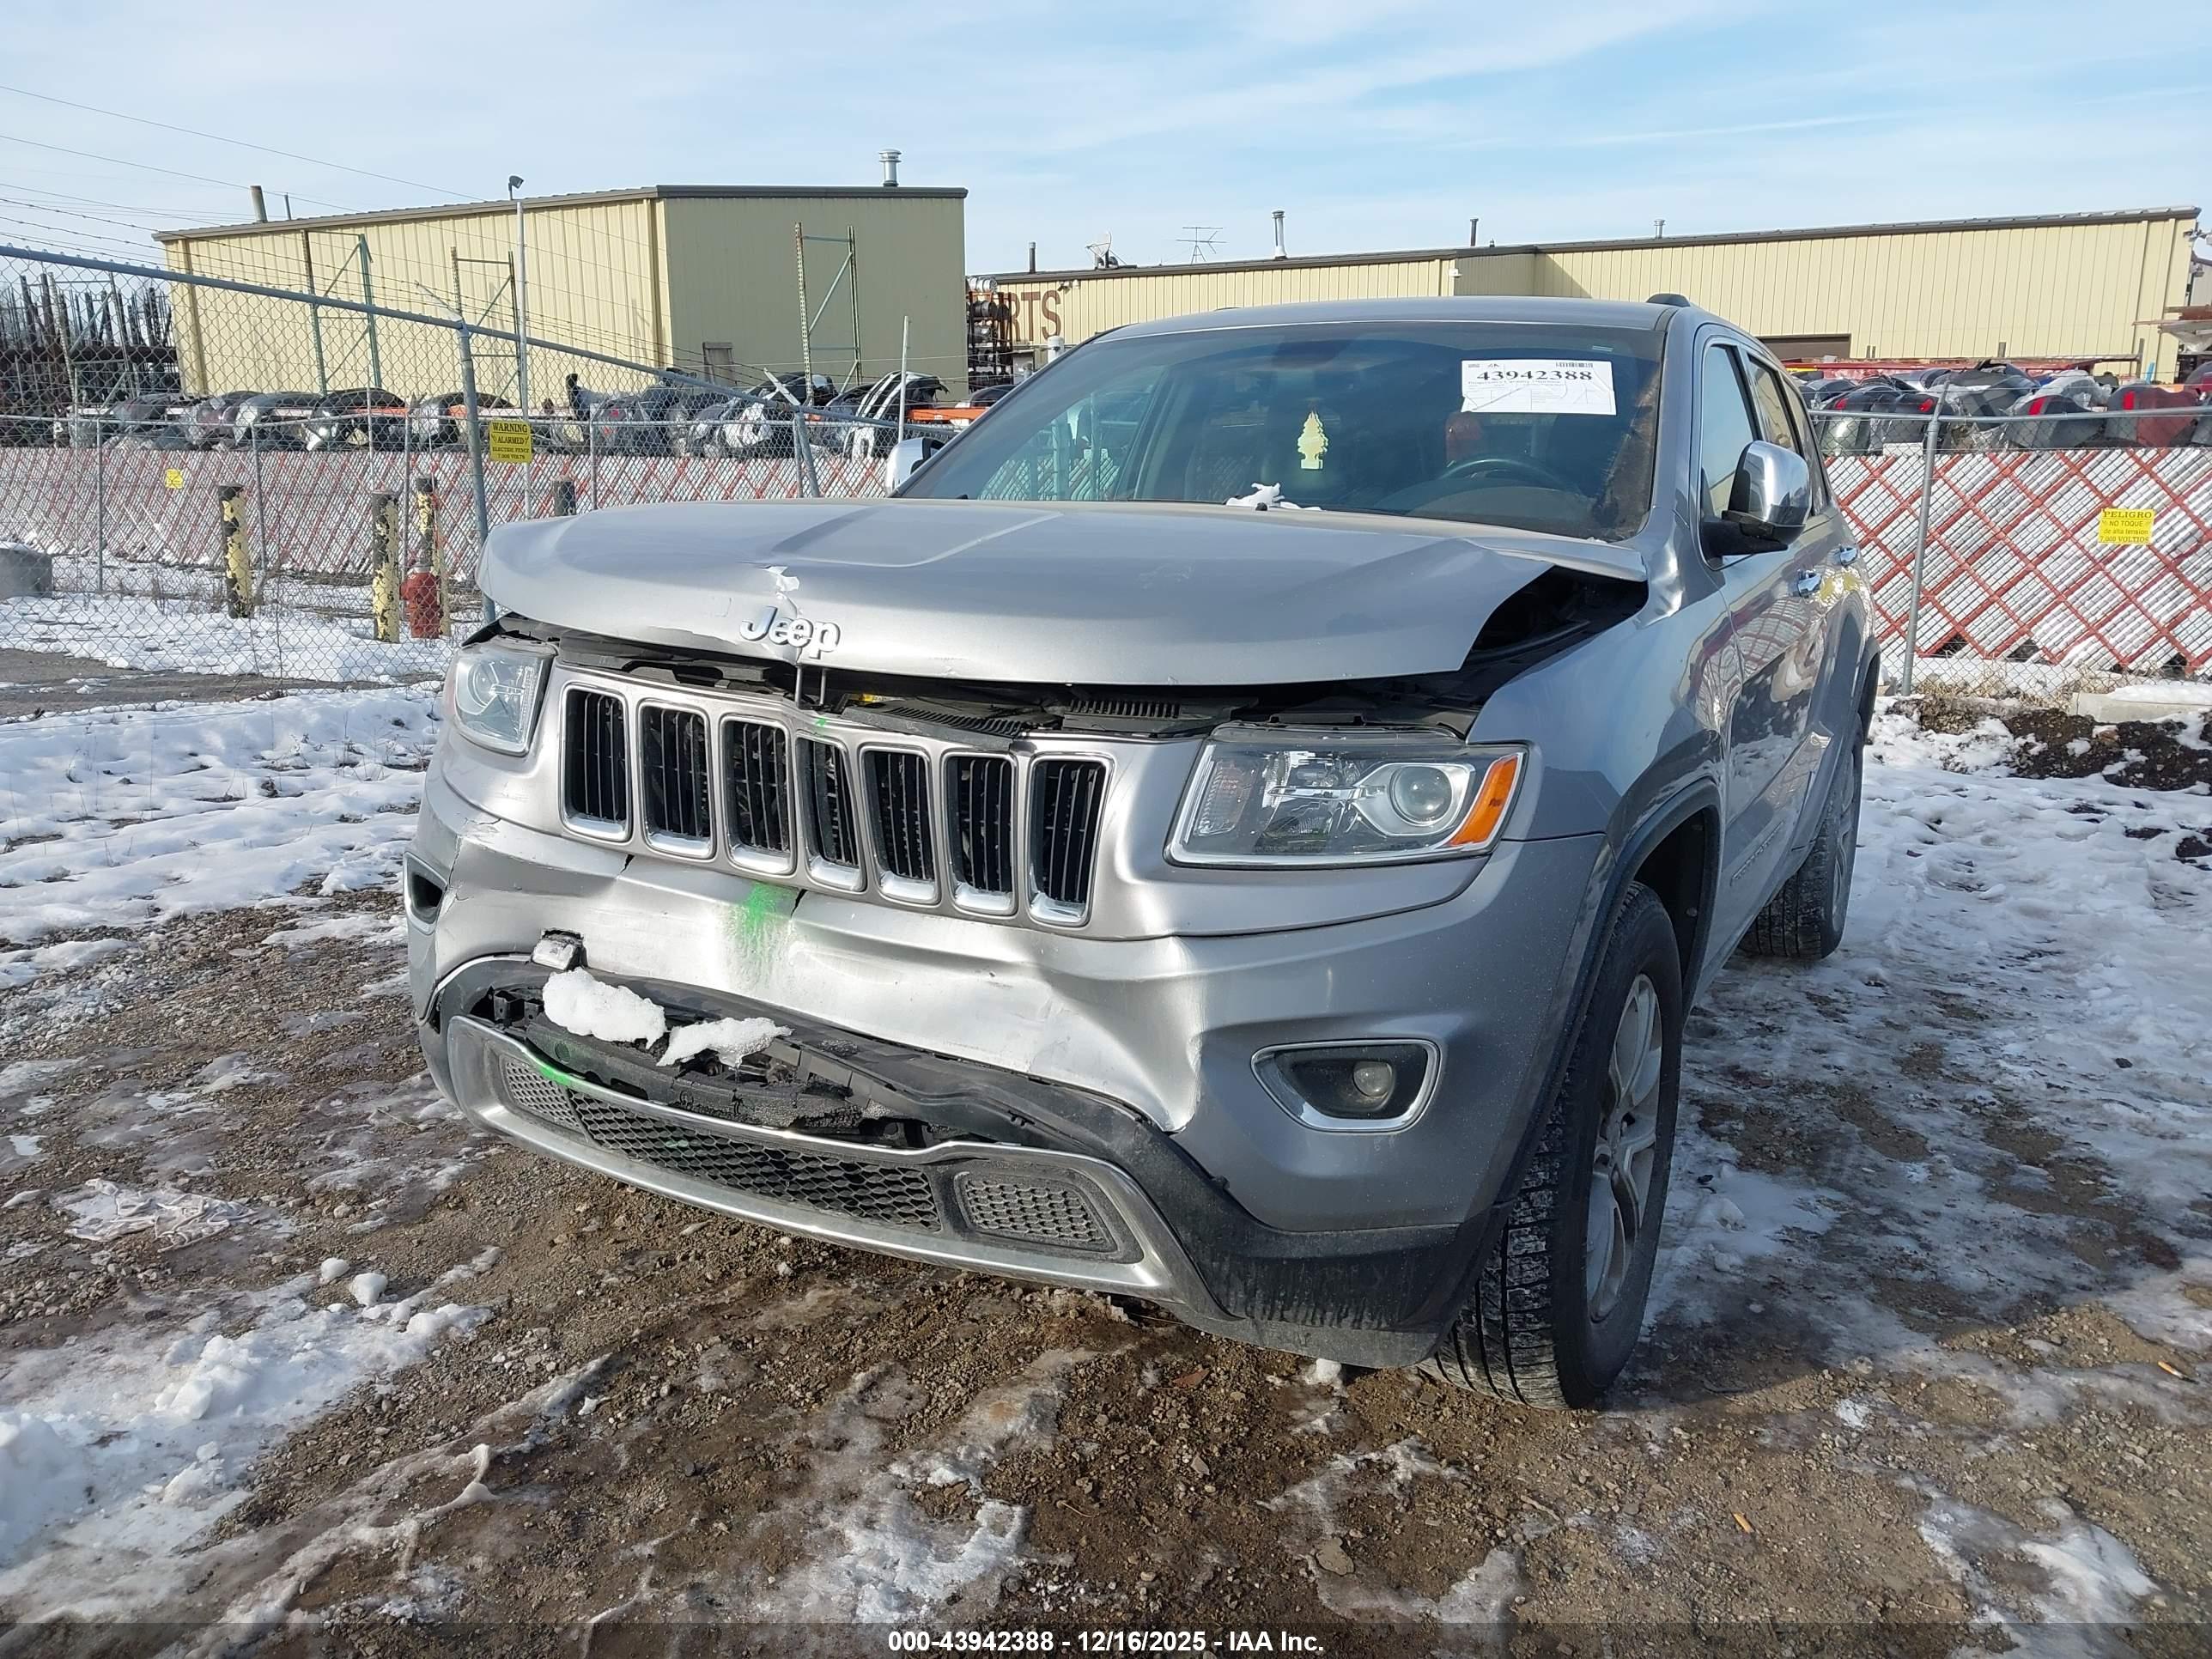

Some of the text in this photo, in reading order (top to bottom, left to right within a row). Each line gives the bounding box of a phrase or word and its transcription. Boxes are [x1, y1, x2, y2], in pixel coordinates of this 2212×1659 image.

[1476, 370, 1593, 380] 43942388
[492, 422, 528, 433] WARNING
[497, 435, 525, 445] ALARMED
[739, 605, 842, 659] Jeep
